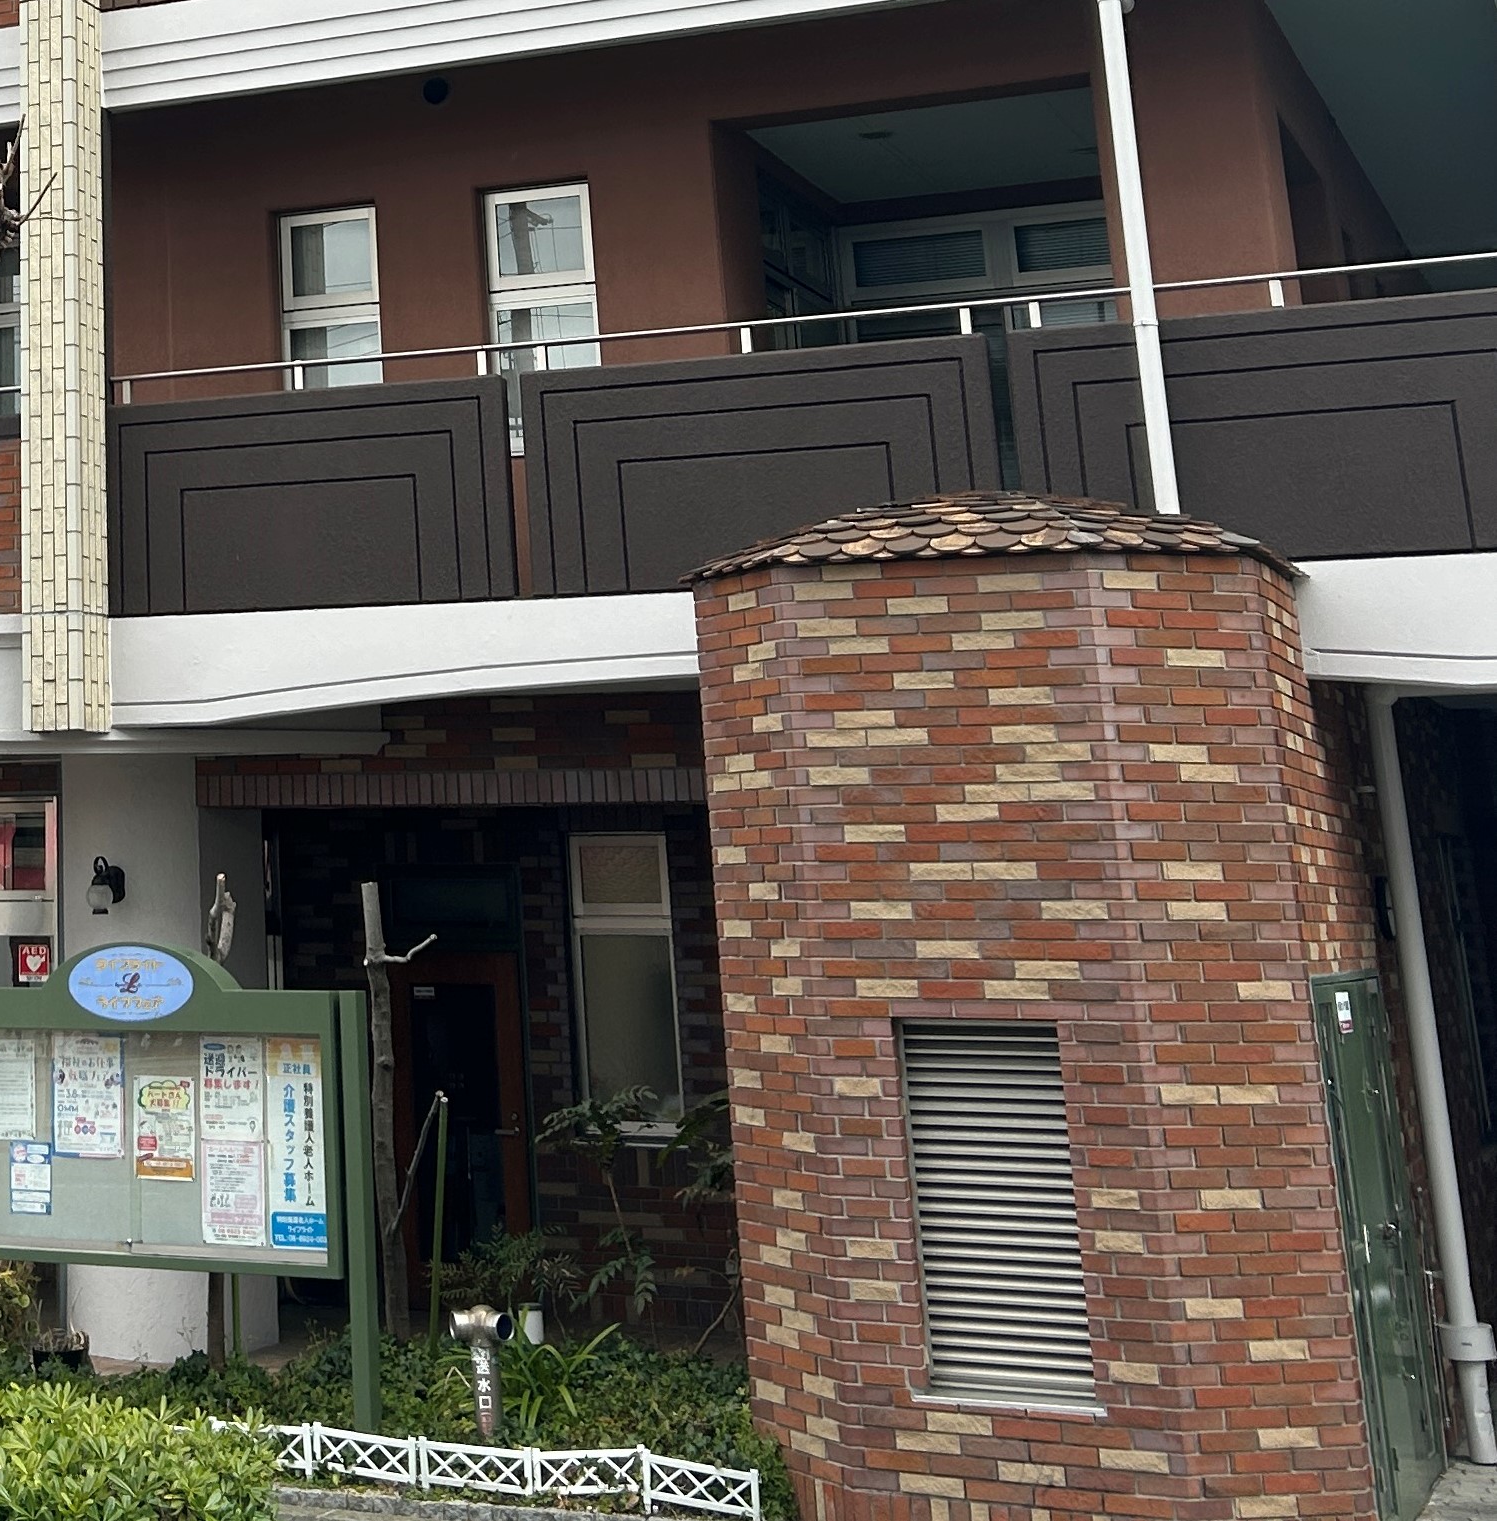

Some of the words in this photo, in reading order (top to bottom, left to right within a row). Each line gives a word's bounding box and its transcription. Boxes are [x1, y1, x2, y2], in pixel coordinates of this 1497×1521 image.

[22, 946, 46, 955] AED
[205, 1066, 257, 1078] ドライバー
[283, 1063, 312, 1076] 正社員
[283, 1083, 297, 1203] 介護スタッフ募集
[476, 1358, 492, 1410] 送水口
